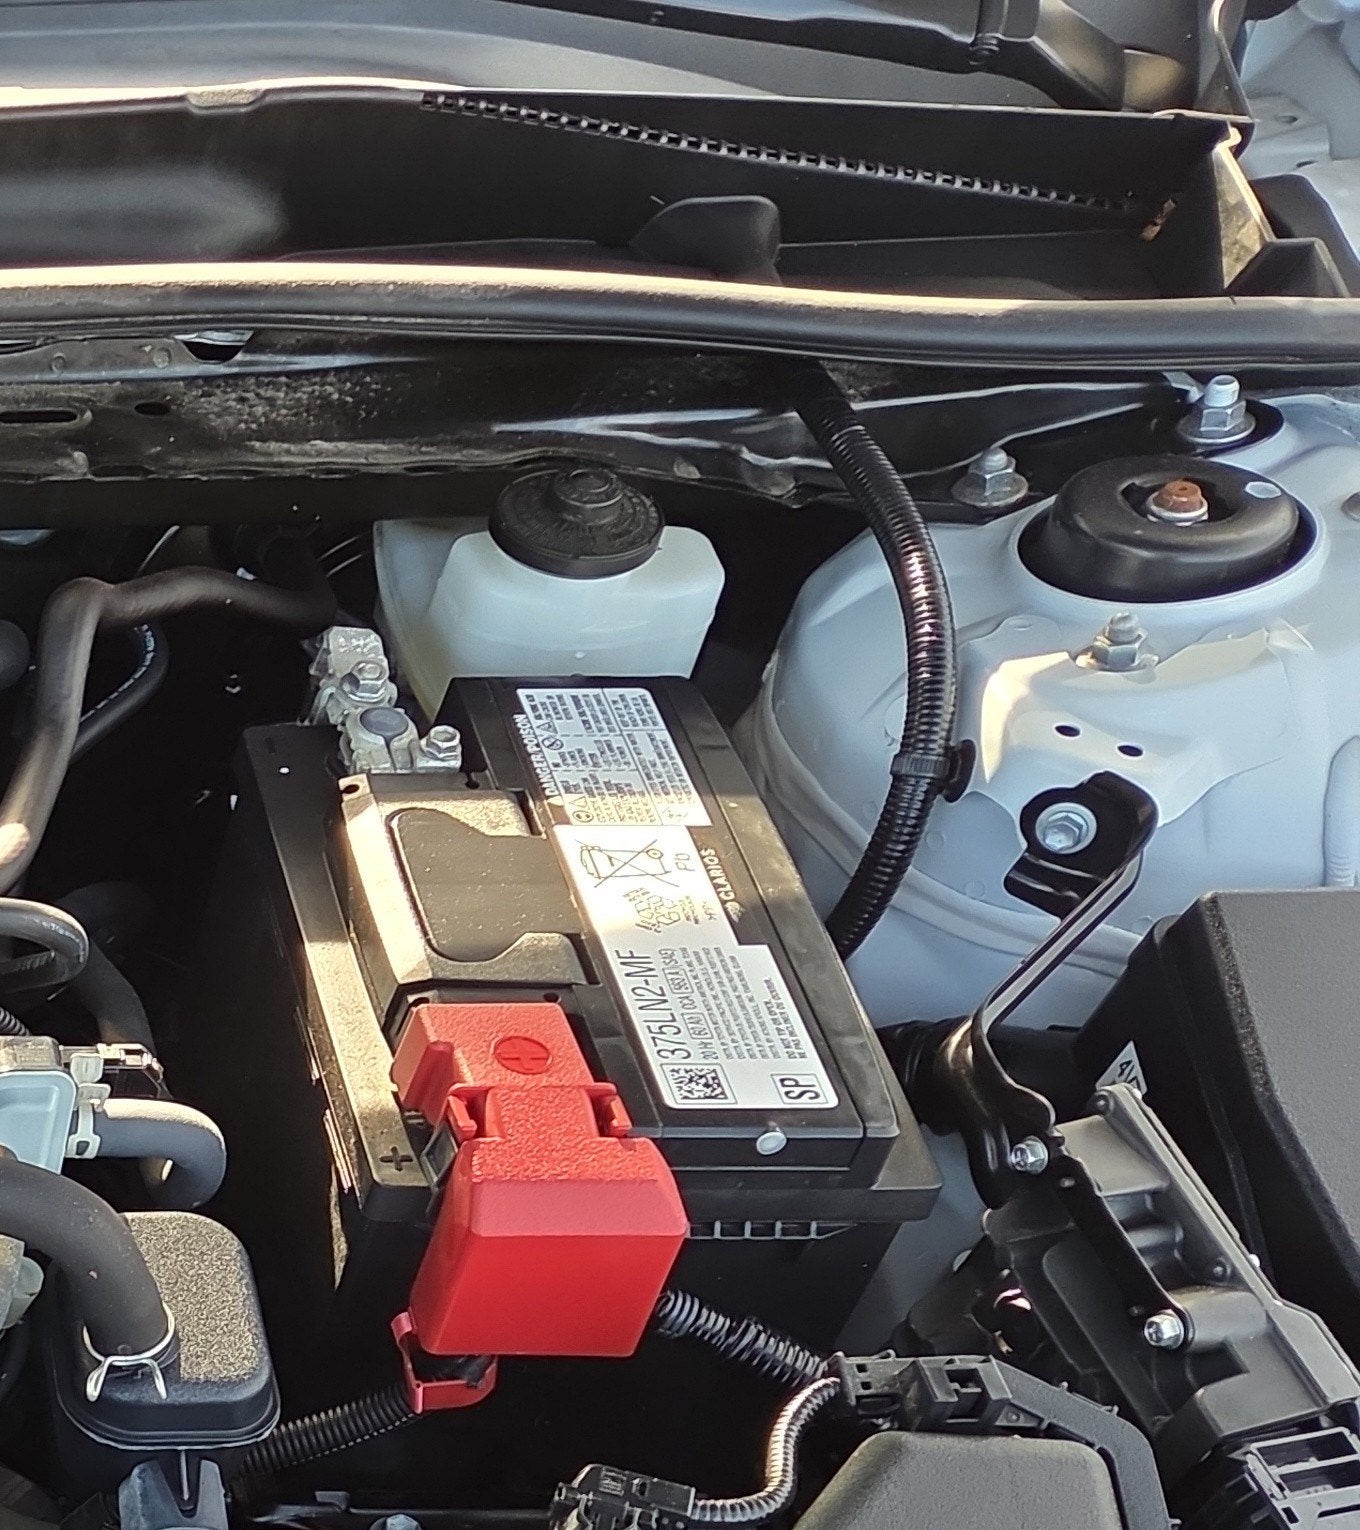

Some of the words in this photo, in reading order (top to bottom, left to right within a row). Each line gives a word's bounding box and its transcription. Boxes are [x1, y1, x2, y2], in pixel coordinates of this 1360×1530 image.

[700, 848, 735, 900] CLARIOS
[613, 949, 692, 1060] 375LN2-MF
[780, 1077, 821, 1101] SP
